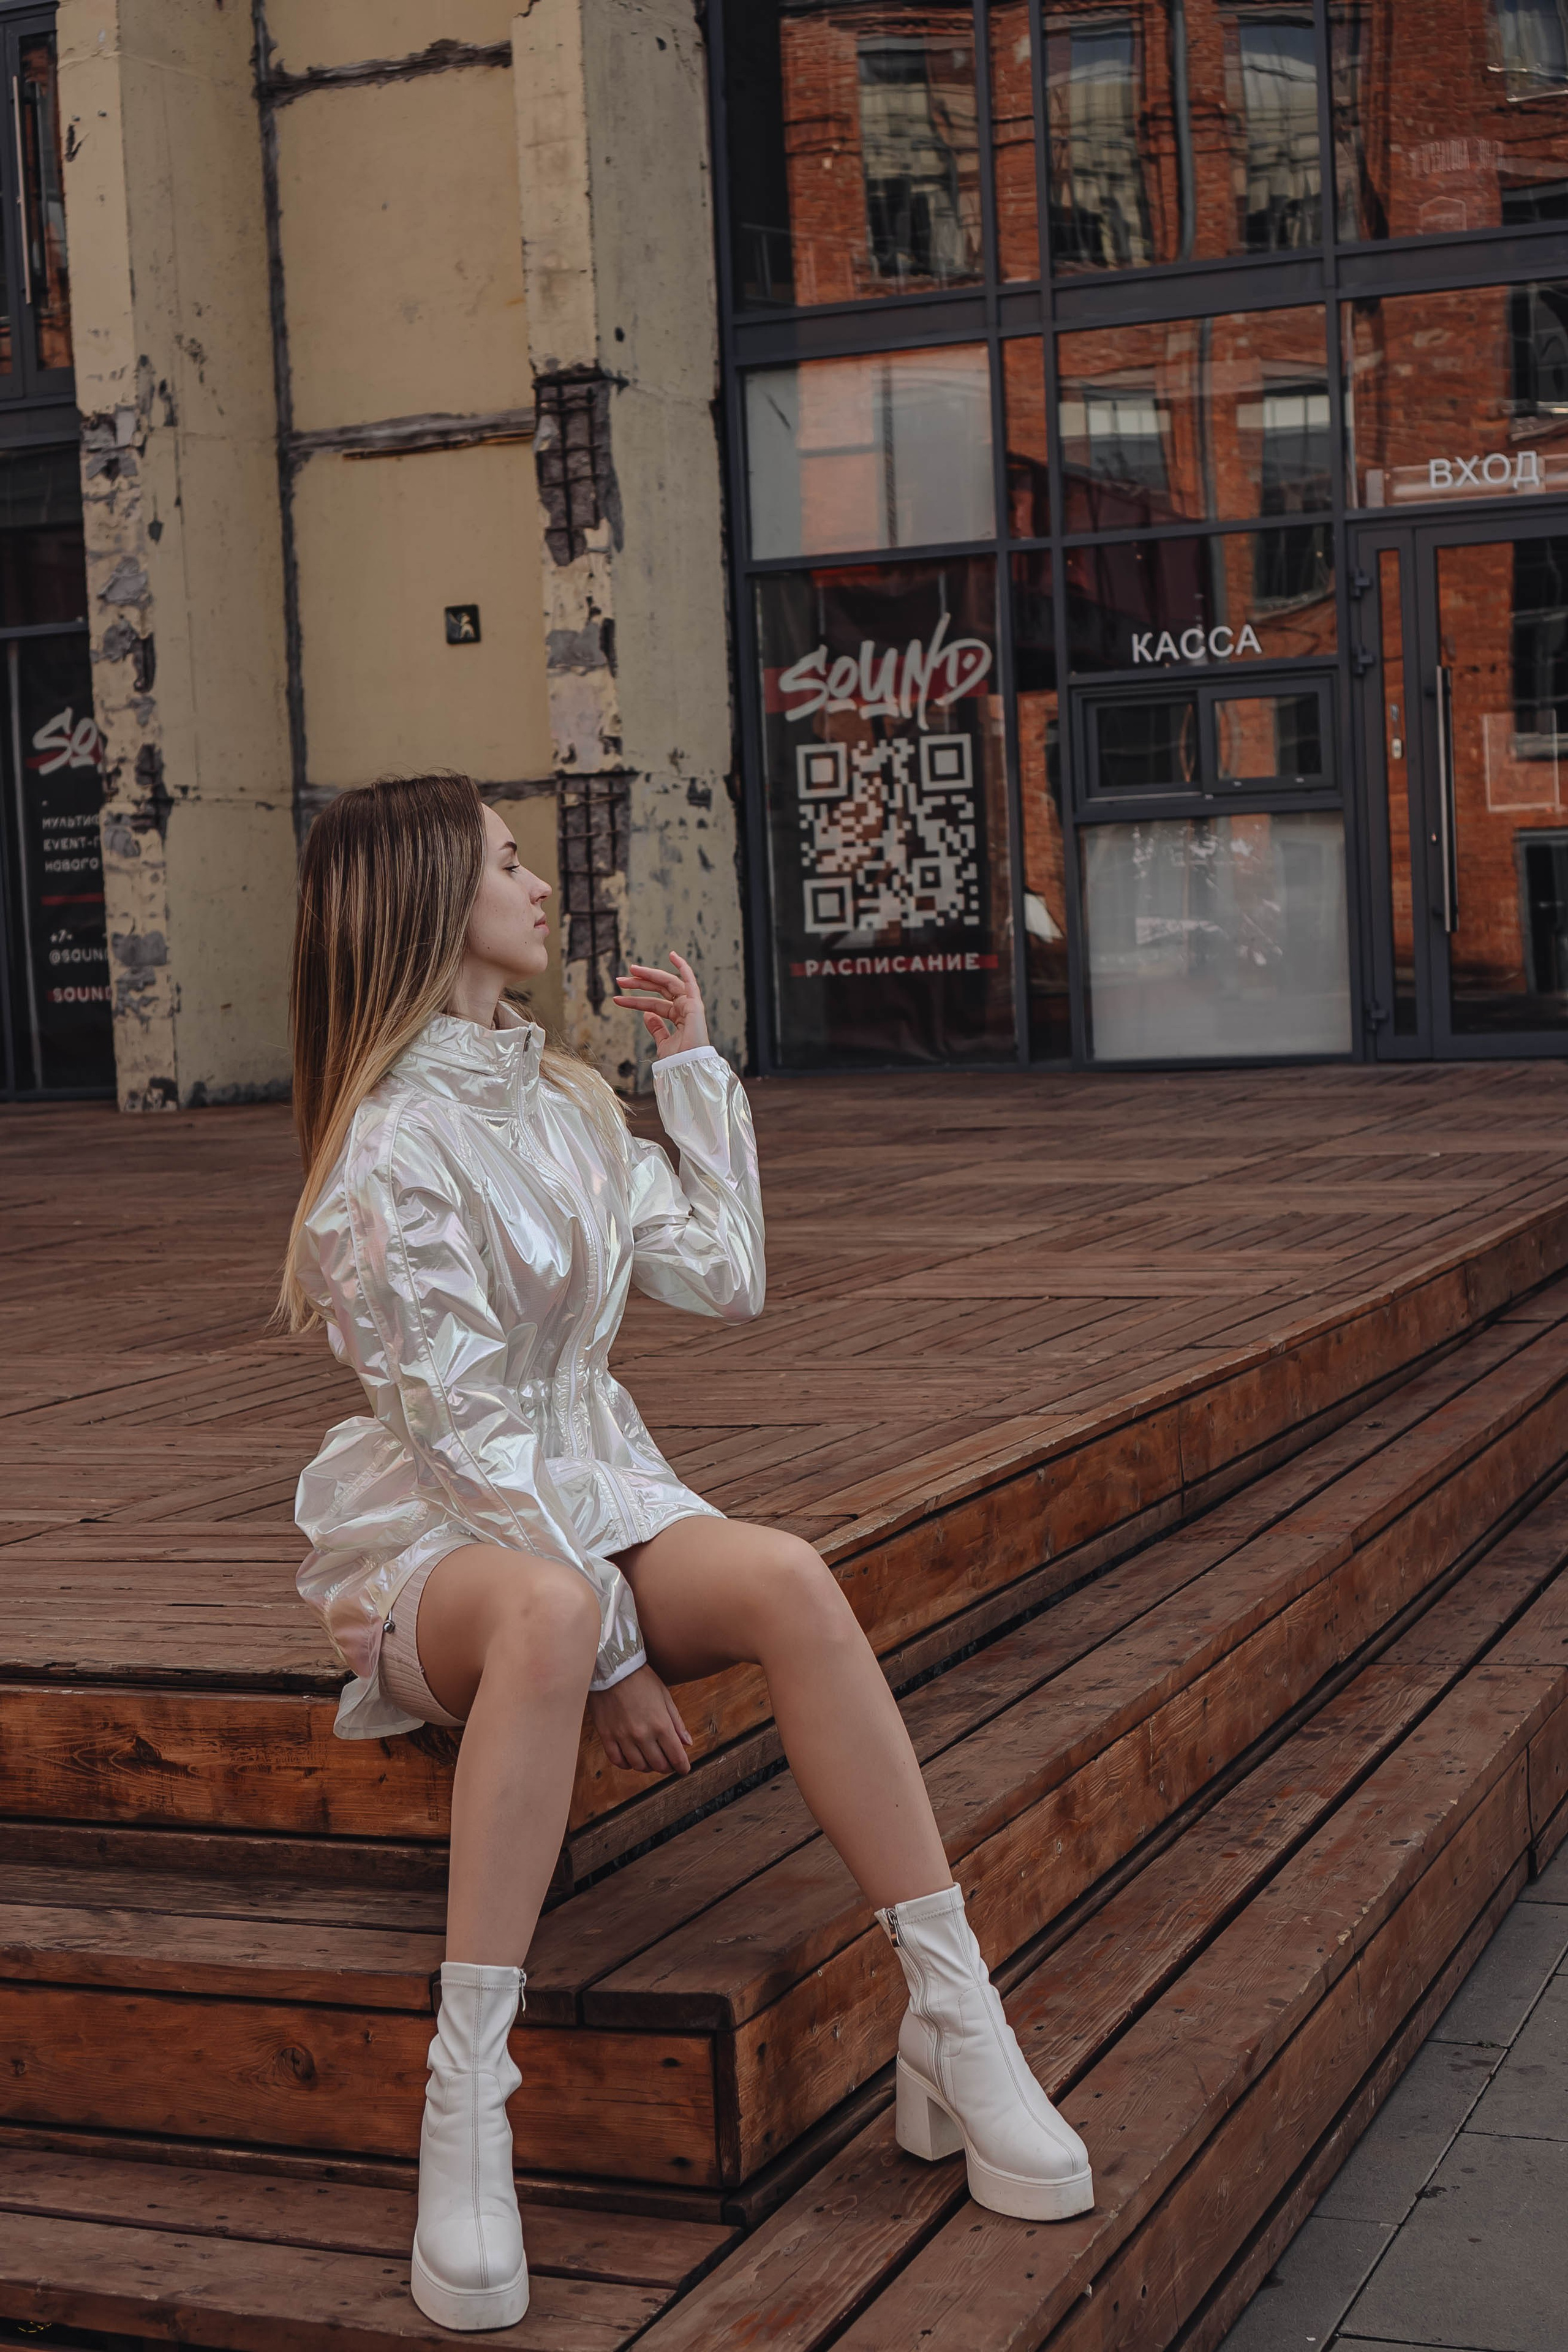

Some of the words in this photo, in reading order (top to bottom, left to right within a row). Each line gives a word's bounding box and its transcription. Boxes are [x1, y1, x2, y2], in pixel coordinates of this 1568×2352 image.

[1428, 450, 1540, 489] ВХОД
[1131, 624, 1262, 663] КАССА
[779, 613, 992, 730] SOUND
[32, 706, 103, 776] SO
[45, 858, 99, 872] НОВОГО
[49, 948, 107, 965] @SOUN
[805, 953, 980, 976] РАСПИСАНИЕ
